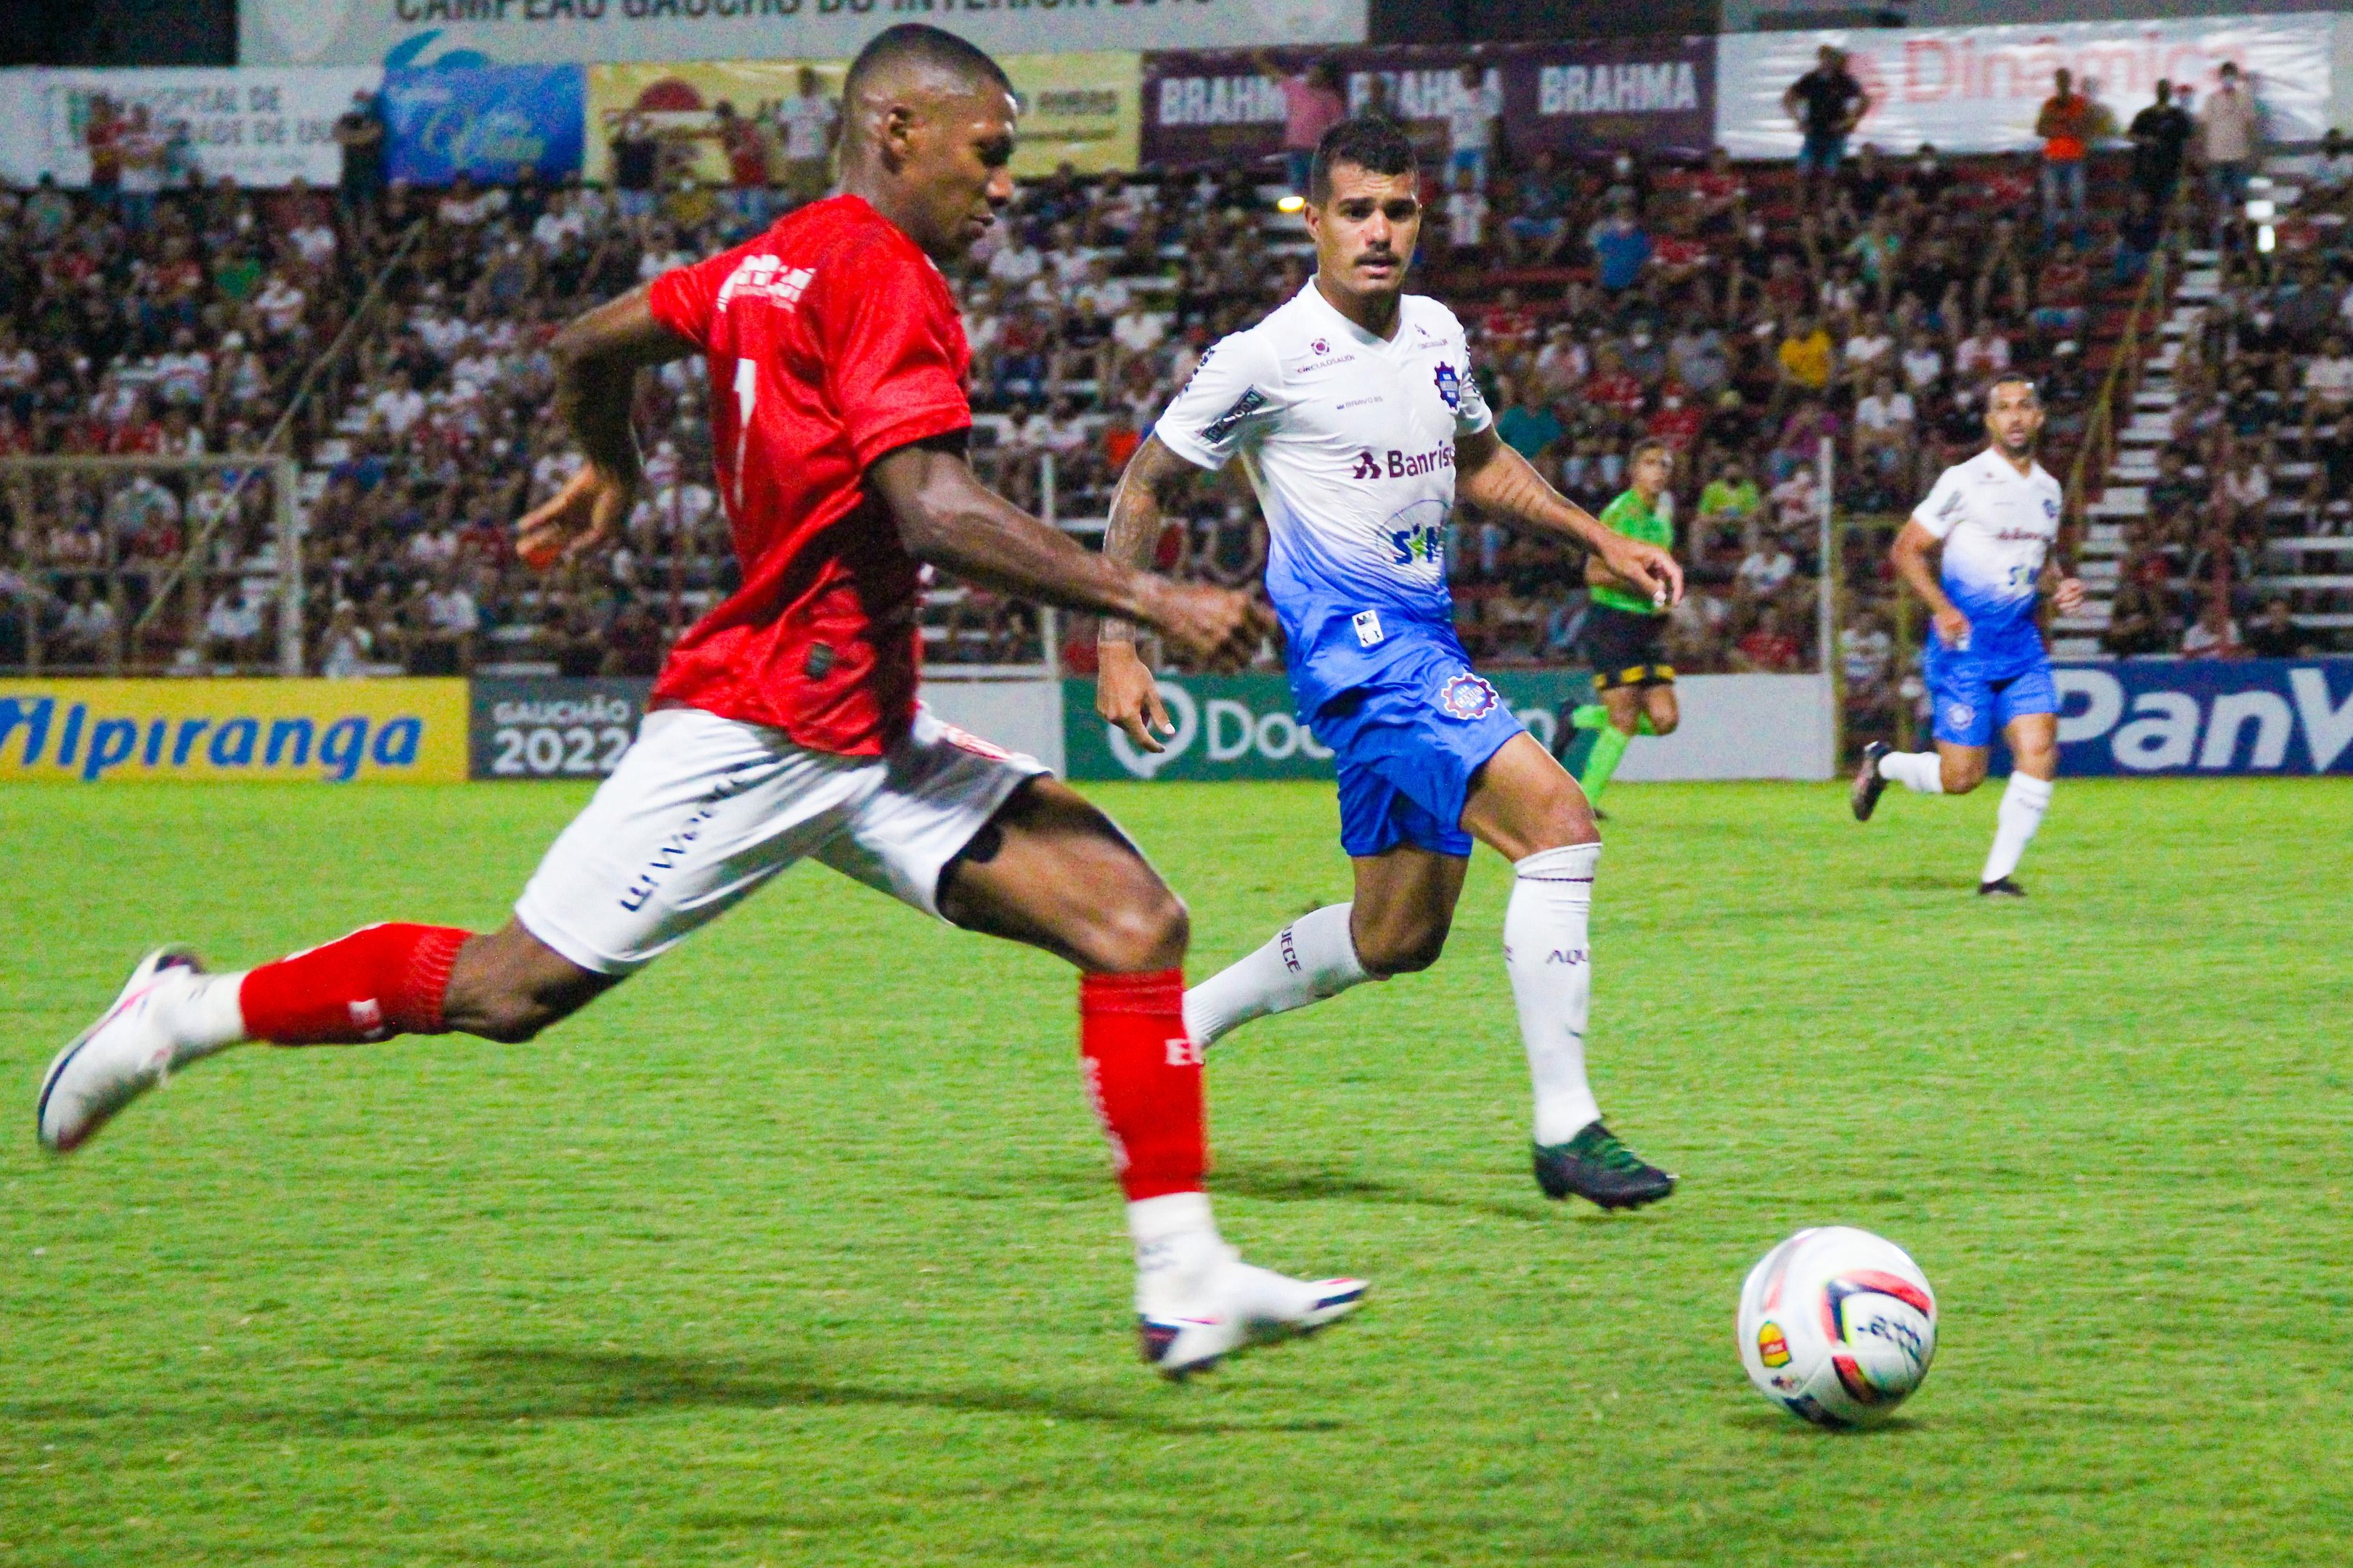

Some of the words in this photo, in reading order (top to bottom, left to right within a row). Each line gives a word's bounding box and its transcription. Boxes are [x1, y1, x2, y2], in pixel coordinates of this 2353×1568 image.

[1159, 75, 1305, 124] BRAHM
[1538, 62, 1698, 114] BRAHMA
[57, 701, 423, 783] Ipiranga
[492, 727, 631, 773] 2022
